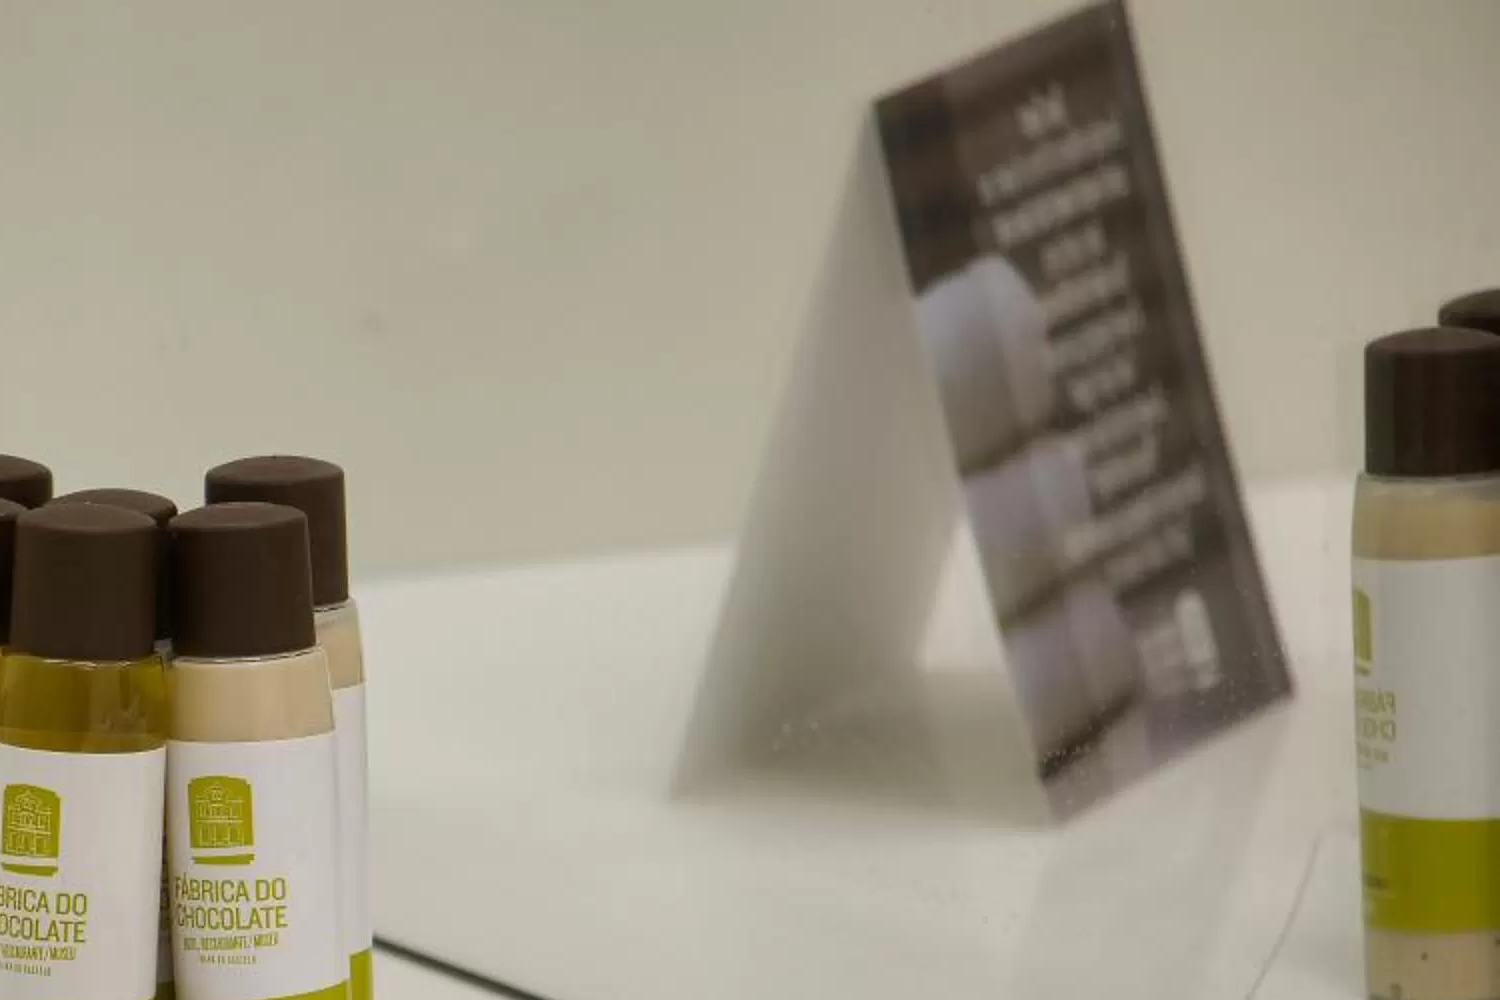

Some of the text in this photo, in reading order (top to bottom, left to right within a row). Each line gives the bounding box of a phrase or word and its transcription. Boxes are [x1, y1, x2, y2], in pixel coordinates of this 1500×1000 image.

[175, 872, 286, 903] FÁBRICA DO
[56, 893, 88, 917] DO
[177, 903, 288, 931] CHOCOLATE
